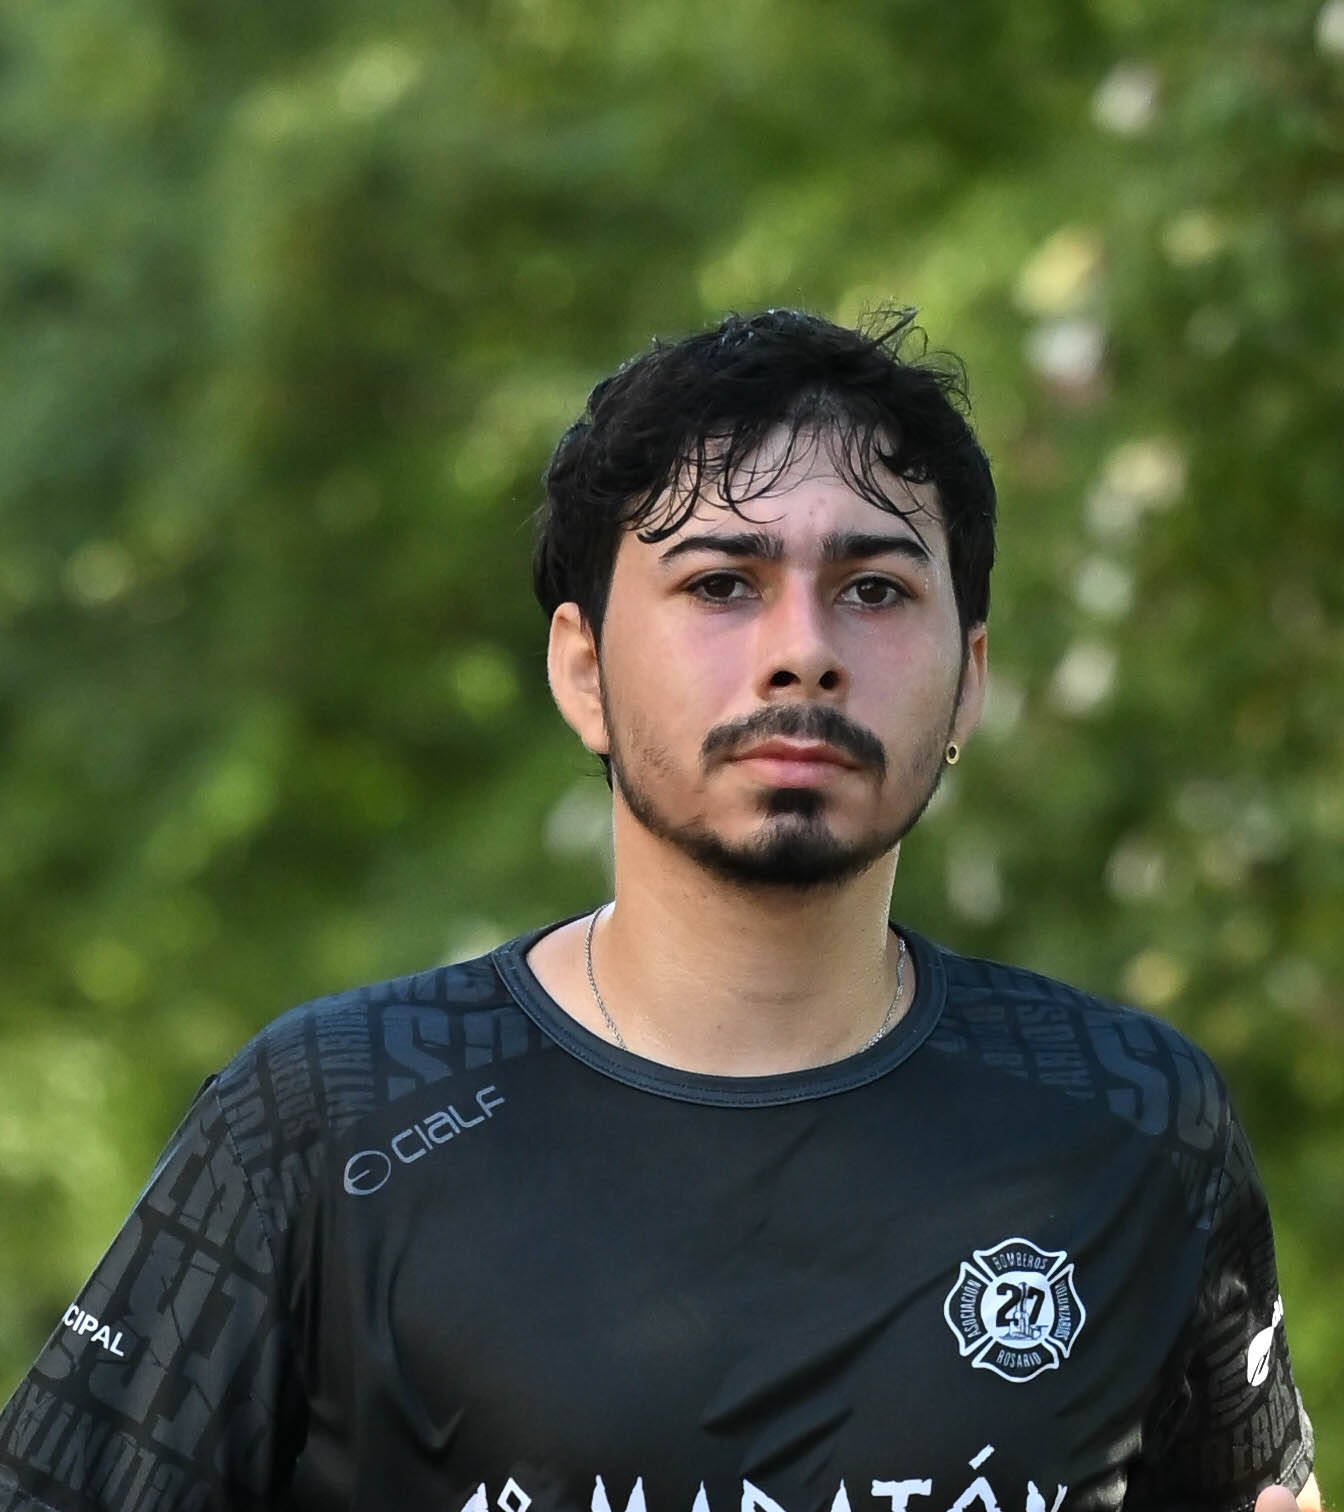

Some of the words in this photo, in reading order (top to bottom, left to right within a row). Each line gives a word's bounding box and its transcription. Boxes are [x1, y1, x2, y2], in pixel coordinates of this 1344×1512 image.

[992, 1252, 1048, 1271] BOMBEROS
[996, 1282, 1045, 1327] 27
[996, 1349, 1042, 1368] ROSARIO
